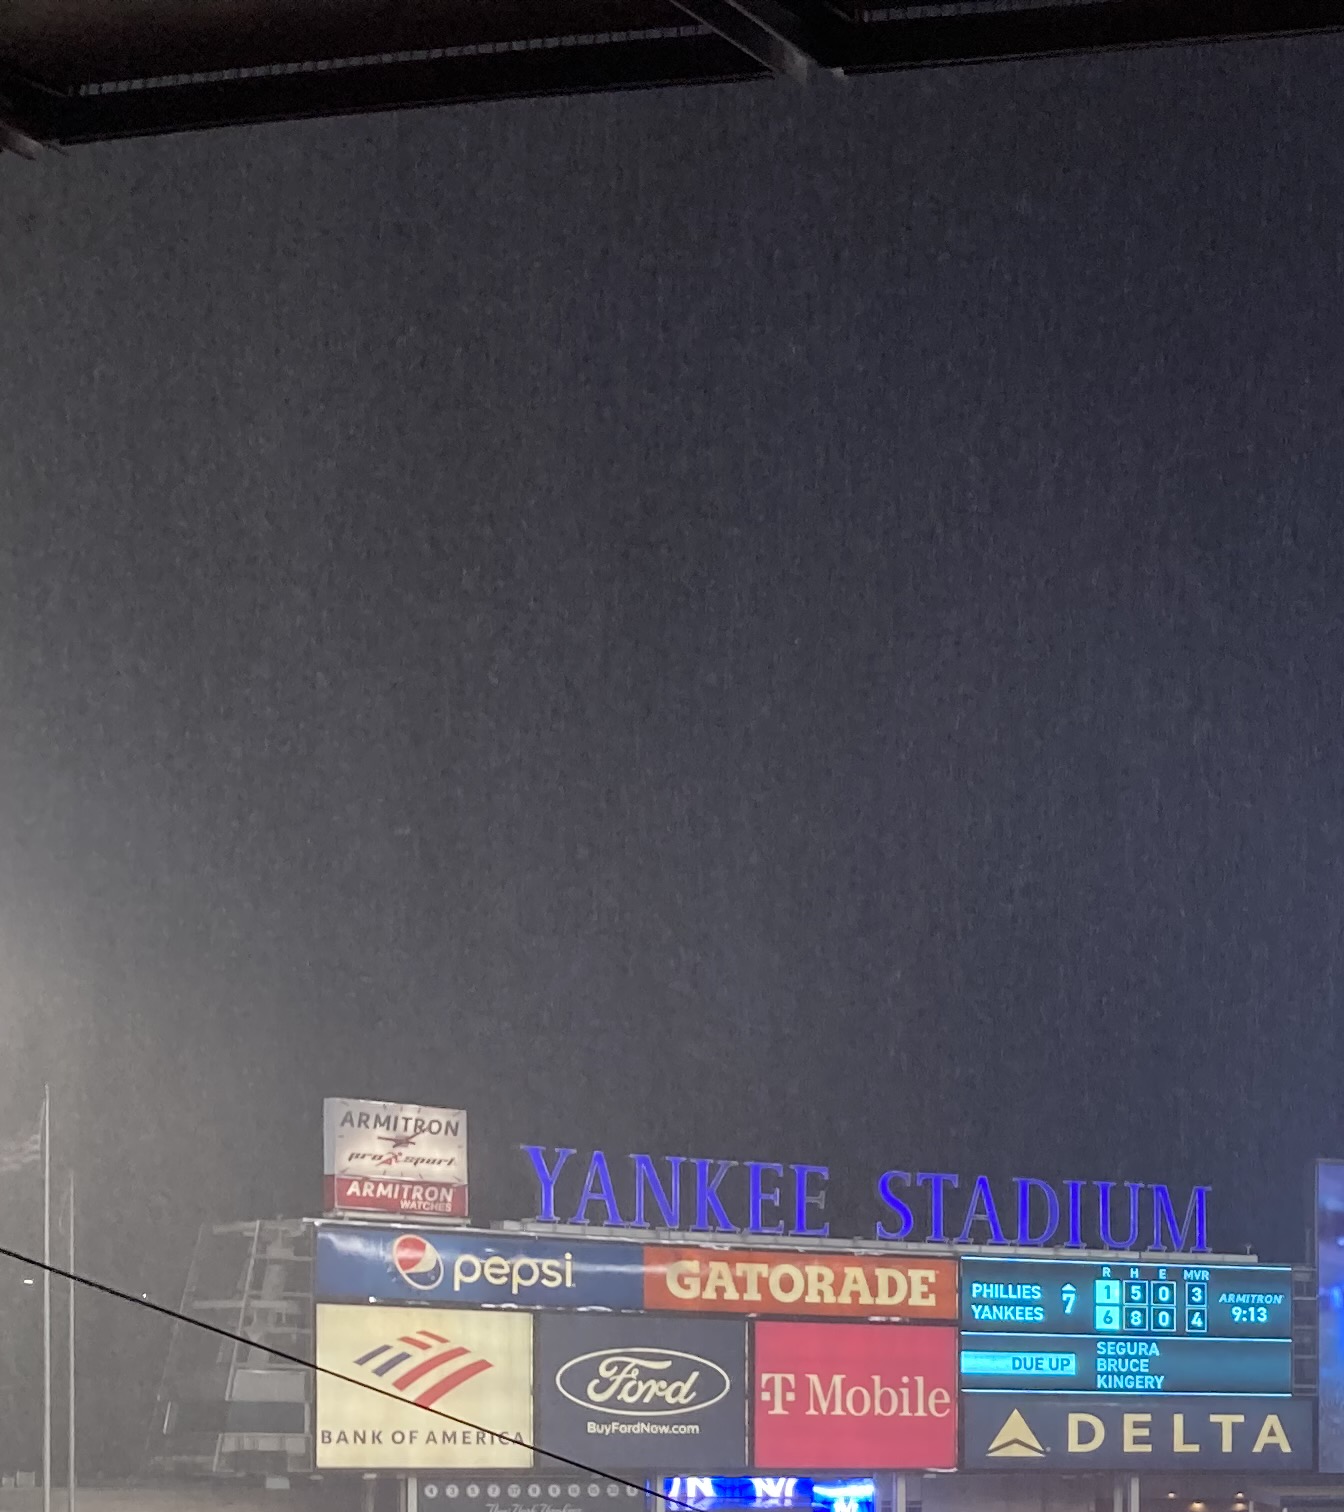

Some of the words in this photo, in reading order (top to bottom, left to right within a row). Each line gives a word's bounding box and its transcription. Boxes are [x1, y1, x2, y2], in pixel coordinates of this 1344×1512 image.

[341, 1110, 459, 1136] ARMITRON
[346, 1181, 453, 1202] ARMITRON
[521, 1145, 830, 1237] YANKEE
[876, 1170, 1212, 1254] STADIUM
[400, 1200, 452, 1212] WATCHES
[453, 1252, 574, 1293] pepsi
[1103, 1267, 1112, 1278] R
[1130, 1268, 1139, 1279] H
[1158, 1269, 1167, 1280] E
[1183, 1269, 1210, 1281] MVR
[665, 1259, 937, 1307] GATORADE
[971, 1283, 1042, 1300] PHILLIES
[1062, 1293, 1076, 1314] 7
[1103, 1284, 1111, 1300] 1
[1130, 1286, 1141, 1300] 5
[1158, 1287, 1170, 1301] 0
[1191, 1287, 1202, 1302] 3
[1218, 1293, 1283, 1305] ARMITRON
[971, 1304, 1044, 1321] YANKEES
[1102, 1311, 1113, 1325] 6
[1130, 1312, 1141, 1326] 8
[1158, 1312, 1170, 1327] 0
[1191, 1313, 1203, 1327] 4
[1231, 1307, 1268, 1323] 9:13
[1096, 1342, 1160, 1357] SEGURA
[1011, 1357, 1044, 1371] DUE
[1048, 1357, 1071, 1371] UP
[1096, 1358, 1149, 1373] BRUCE
[587, 1356, 698, 1404] Ford
[1096, 1375, 1165, 1390] KINGERY
[760, 1373, 796, 1415] T
[806, 1373, 950, 1418] Mobile
[321, 1430, 383, 1445] BANK
[391, 1430, 419, 1445] OF
[425, 1430, 524, 1446] AMERICA
[587, 1421, 700, 1437] BuyFordNow.com
[1067, 1412, 1292, 1454] DELTA
